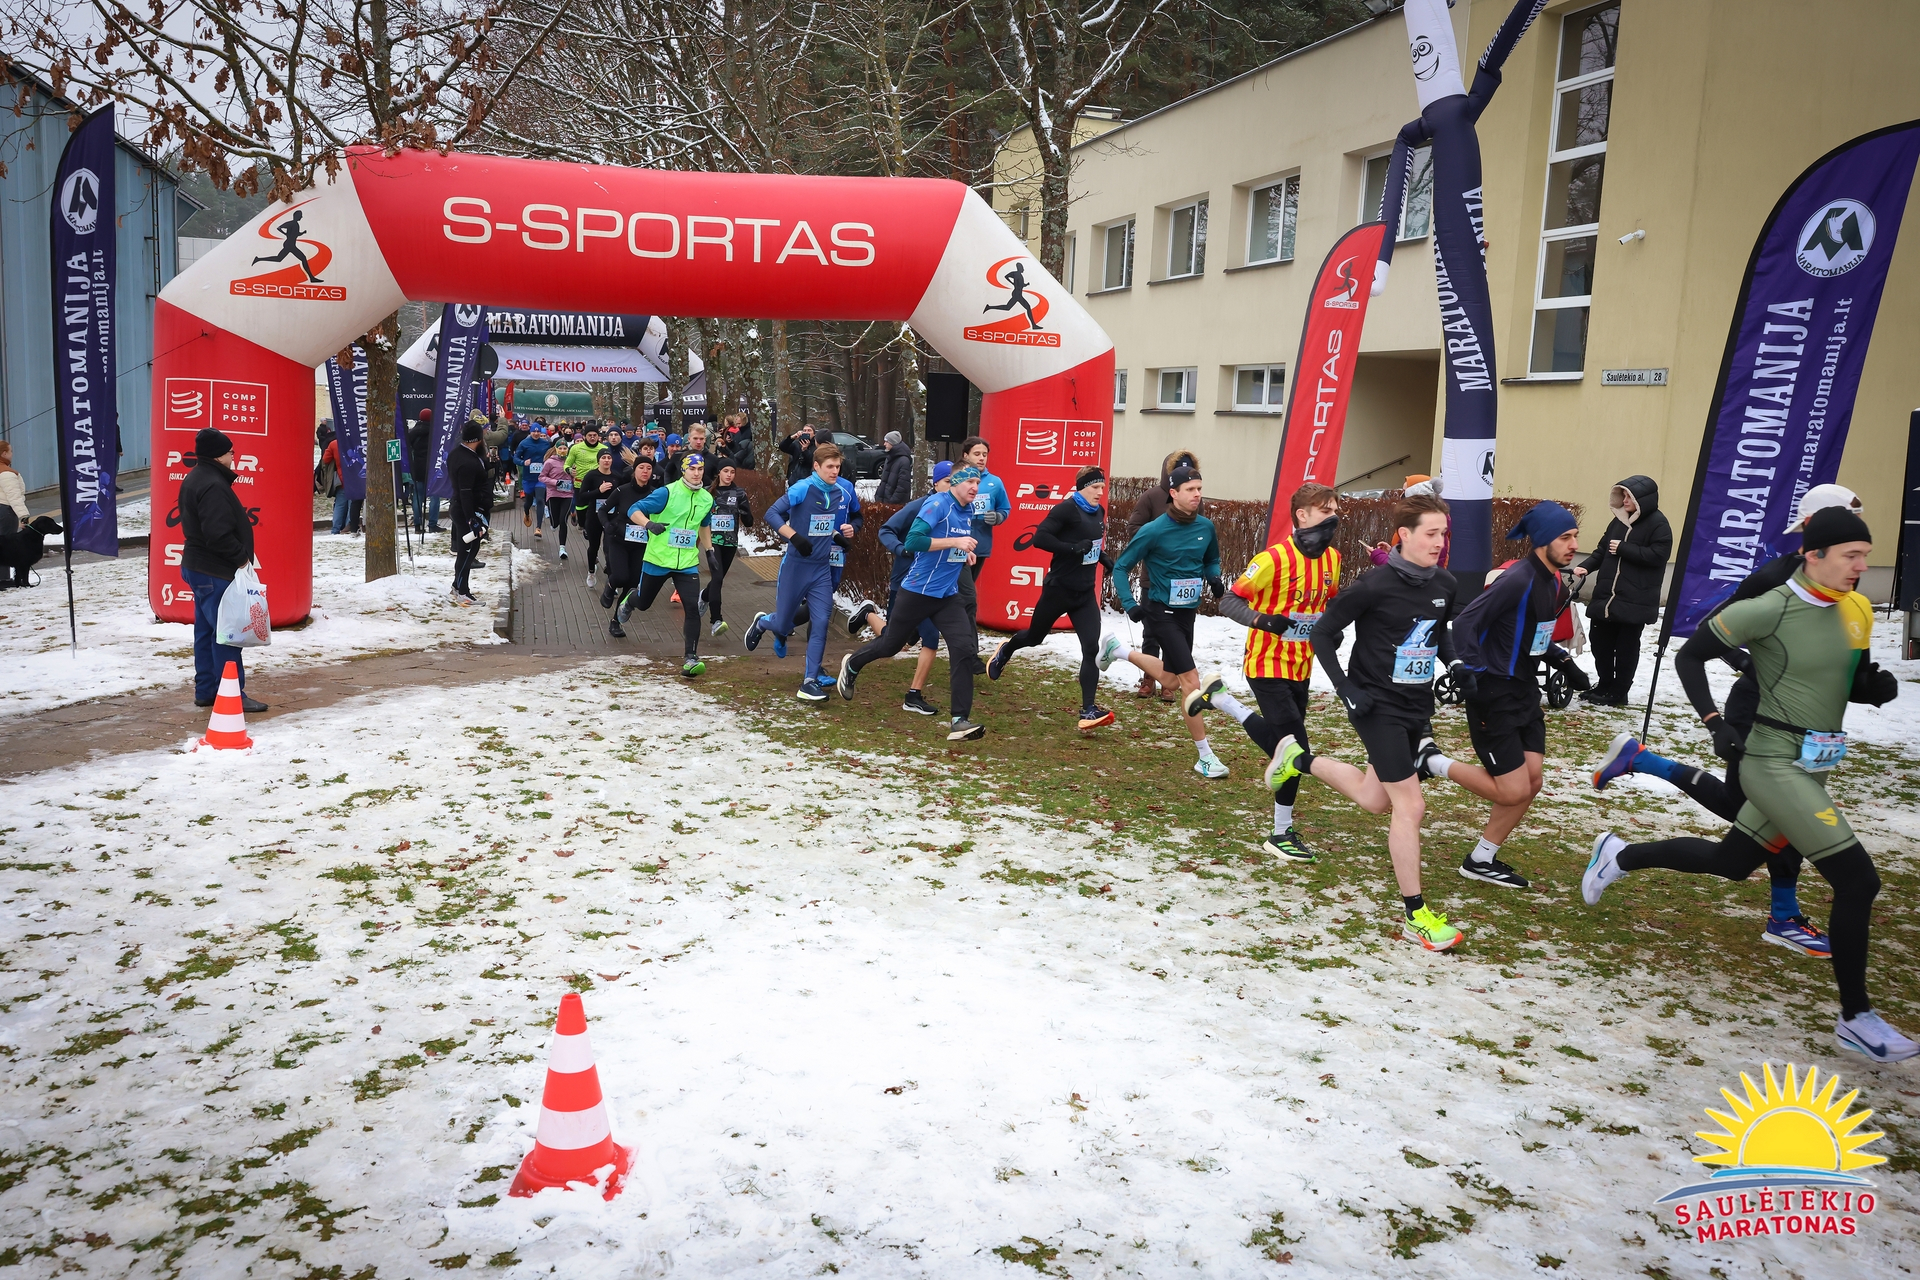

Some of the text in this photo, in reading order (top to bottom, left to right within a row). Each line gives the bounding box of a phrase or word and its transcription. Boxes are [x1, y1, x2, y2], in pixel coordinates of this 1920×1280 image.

[443, 197, 876, 267] S-SPORTAS
[1797, 252, 1866, 277] MARATOMANIJA
[234, 282, 343, 299] S-SPORTAS
[486, 312, 626, 338] MARATOMANIJA
[966, 329, 1058, 346] S-SPORTAS
[506, 358, 638, 374] SAULĖTEKIO MARATONAS
[64, 251, 99, 504] MARATOMANIJA
[1606, 372, 1663, 382] Saulėtekio al. 28
[222, 392, 257, 401] COMP
[222, 403, 256, 413] RESS
[1302, 328, 1344, 483] PORTAS
[659, 408, 706, 416] REVERY
[222, 414, 256, 423] PORT
[1073, 430, 1096, 438] COMP
[1708, 297, 1815, 583] MARATOMANIJA
[1016, 483, 1077, 500] POLA
[715, 520, 731, 528] 405
[814, 521, 830, 531] 402
[629, 530, 645, 539] 412
[674, 535, 691, 545] 135
[1176, 587, 1196, 599] 480
[1293, 623, 1314, 635] 169
[1404, 660, 1432, 675] 438
